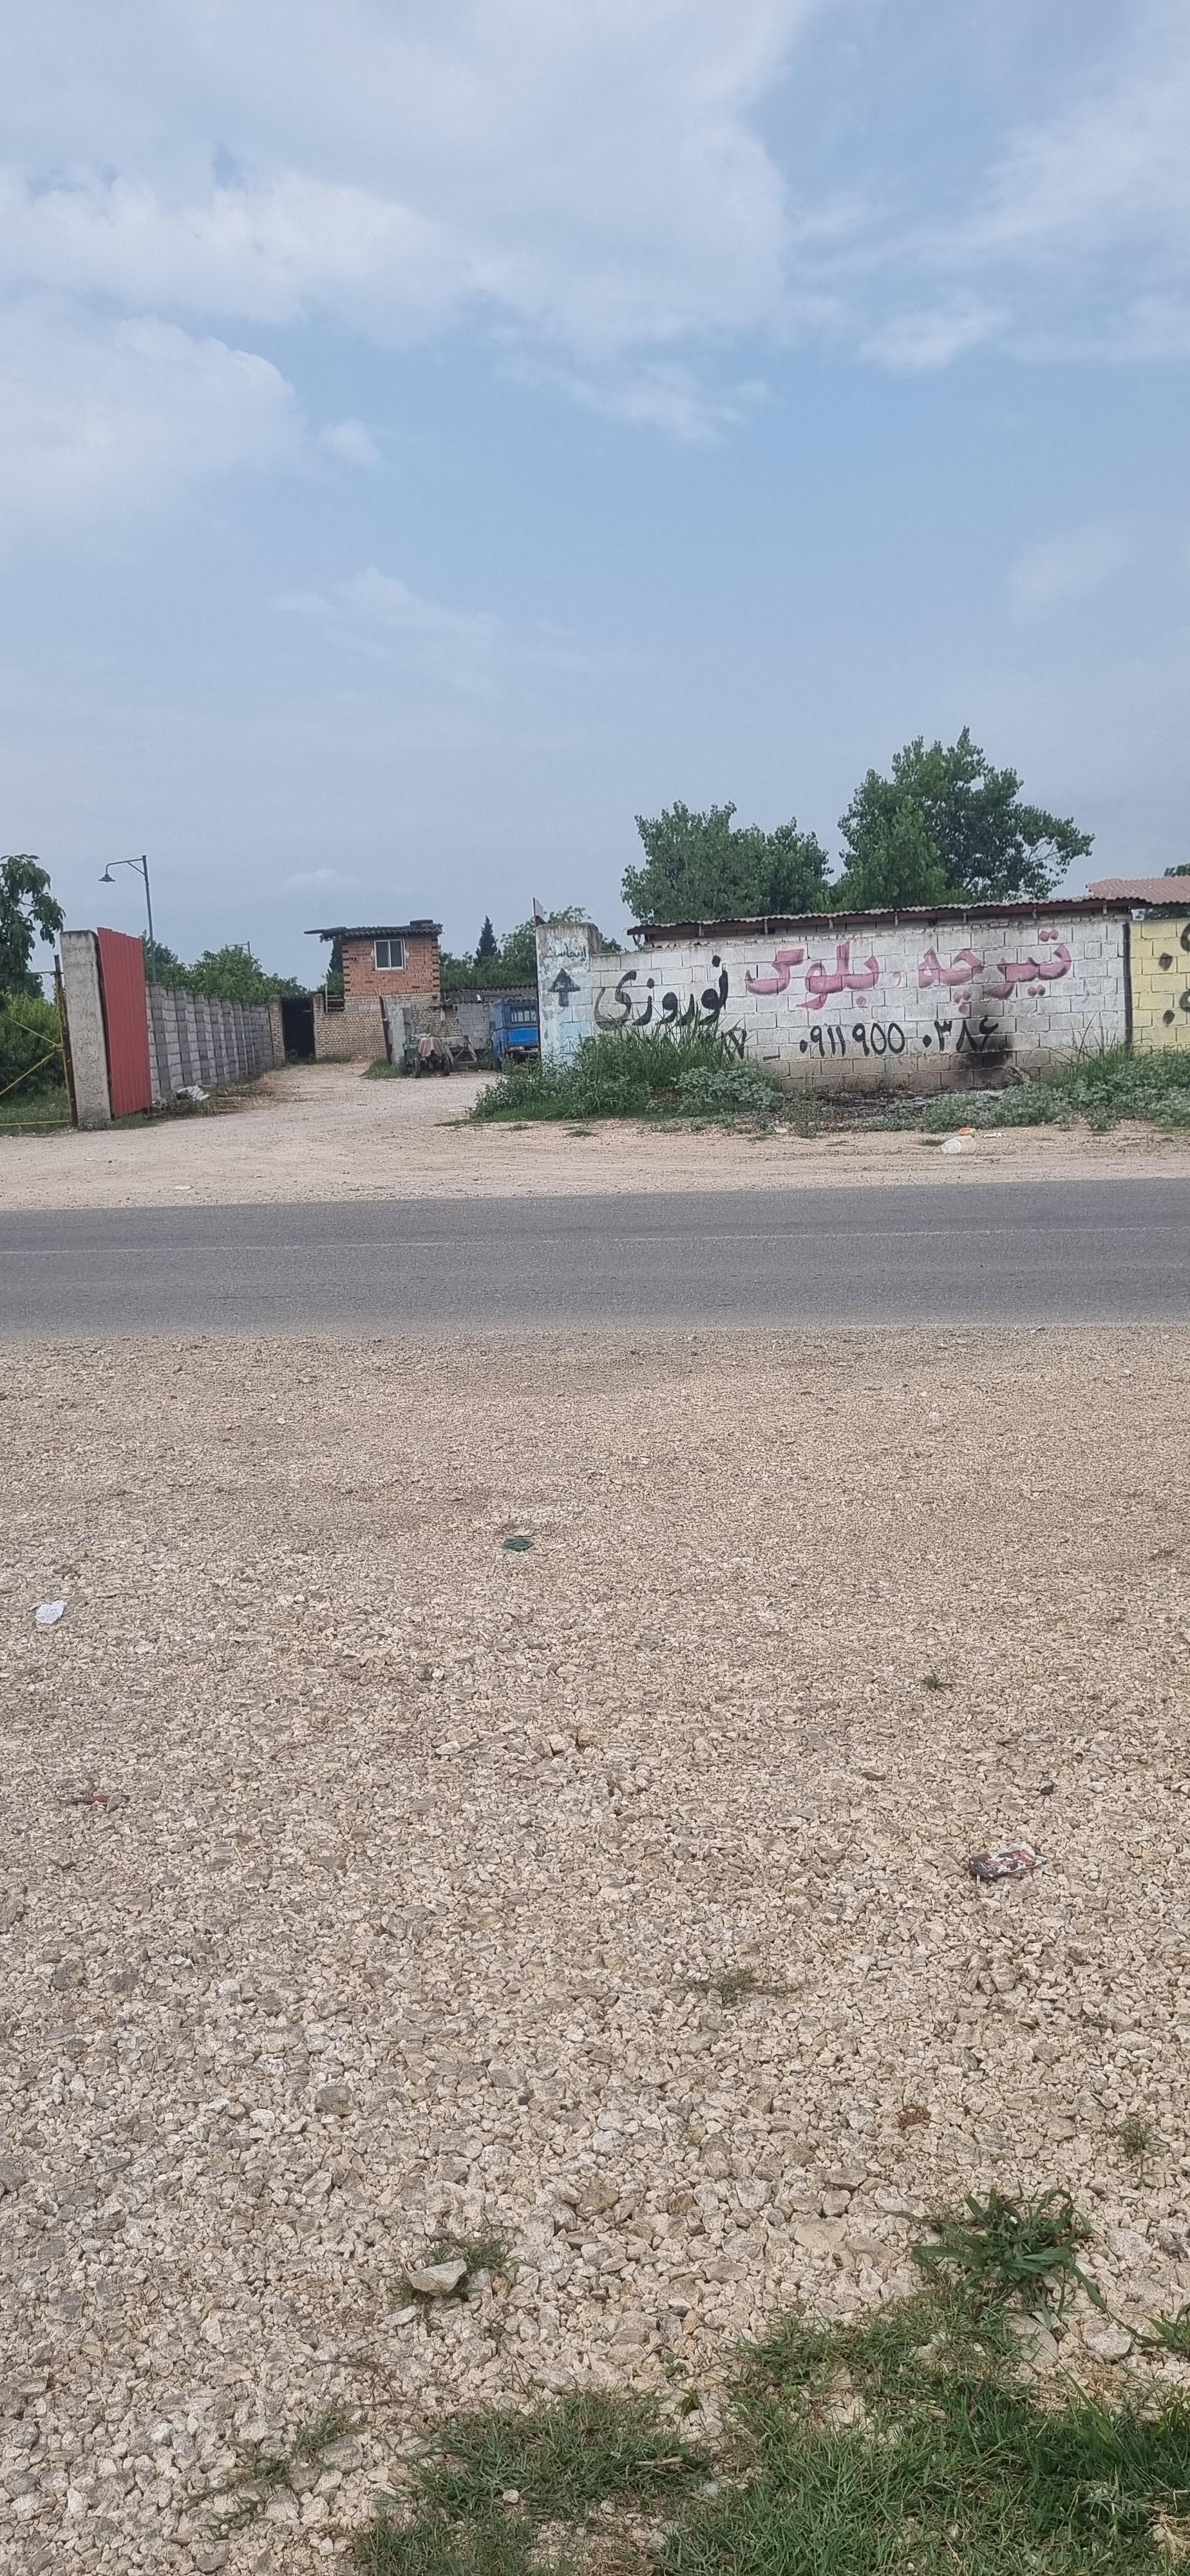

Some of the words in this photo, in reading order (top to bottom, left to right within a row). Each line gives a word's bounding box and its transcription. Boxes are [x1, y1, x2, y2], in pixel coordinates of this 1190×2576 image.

[594, 954, 729, 1032] نوروزی
[746, 941, 879, 1010] بلوک
[918, 929, 1072, 1014] تیرچه
